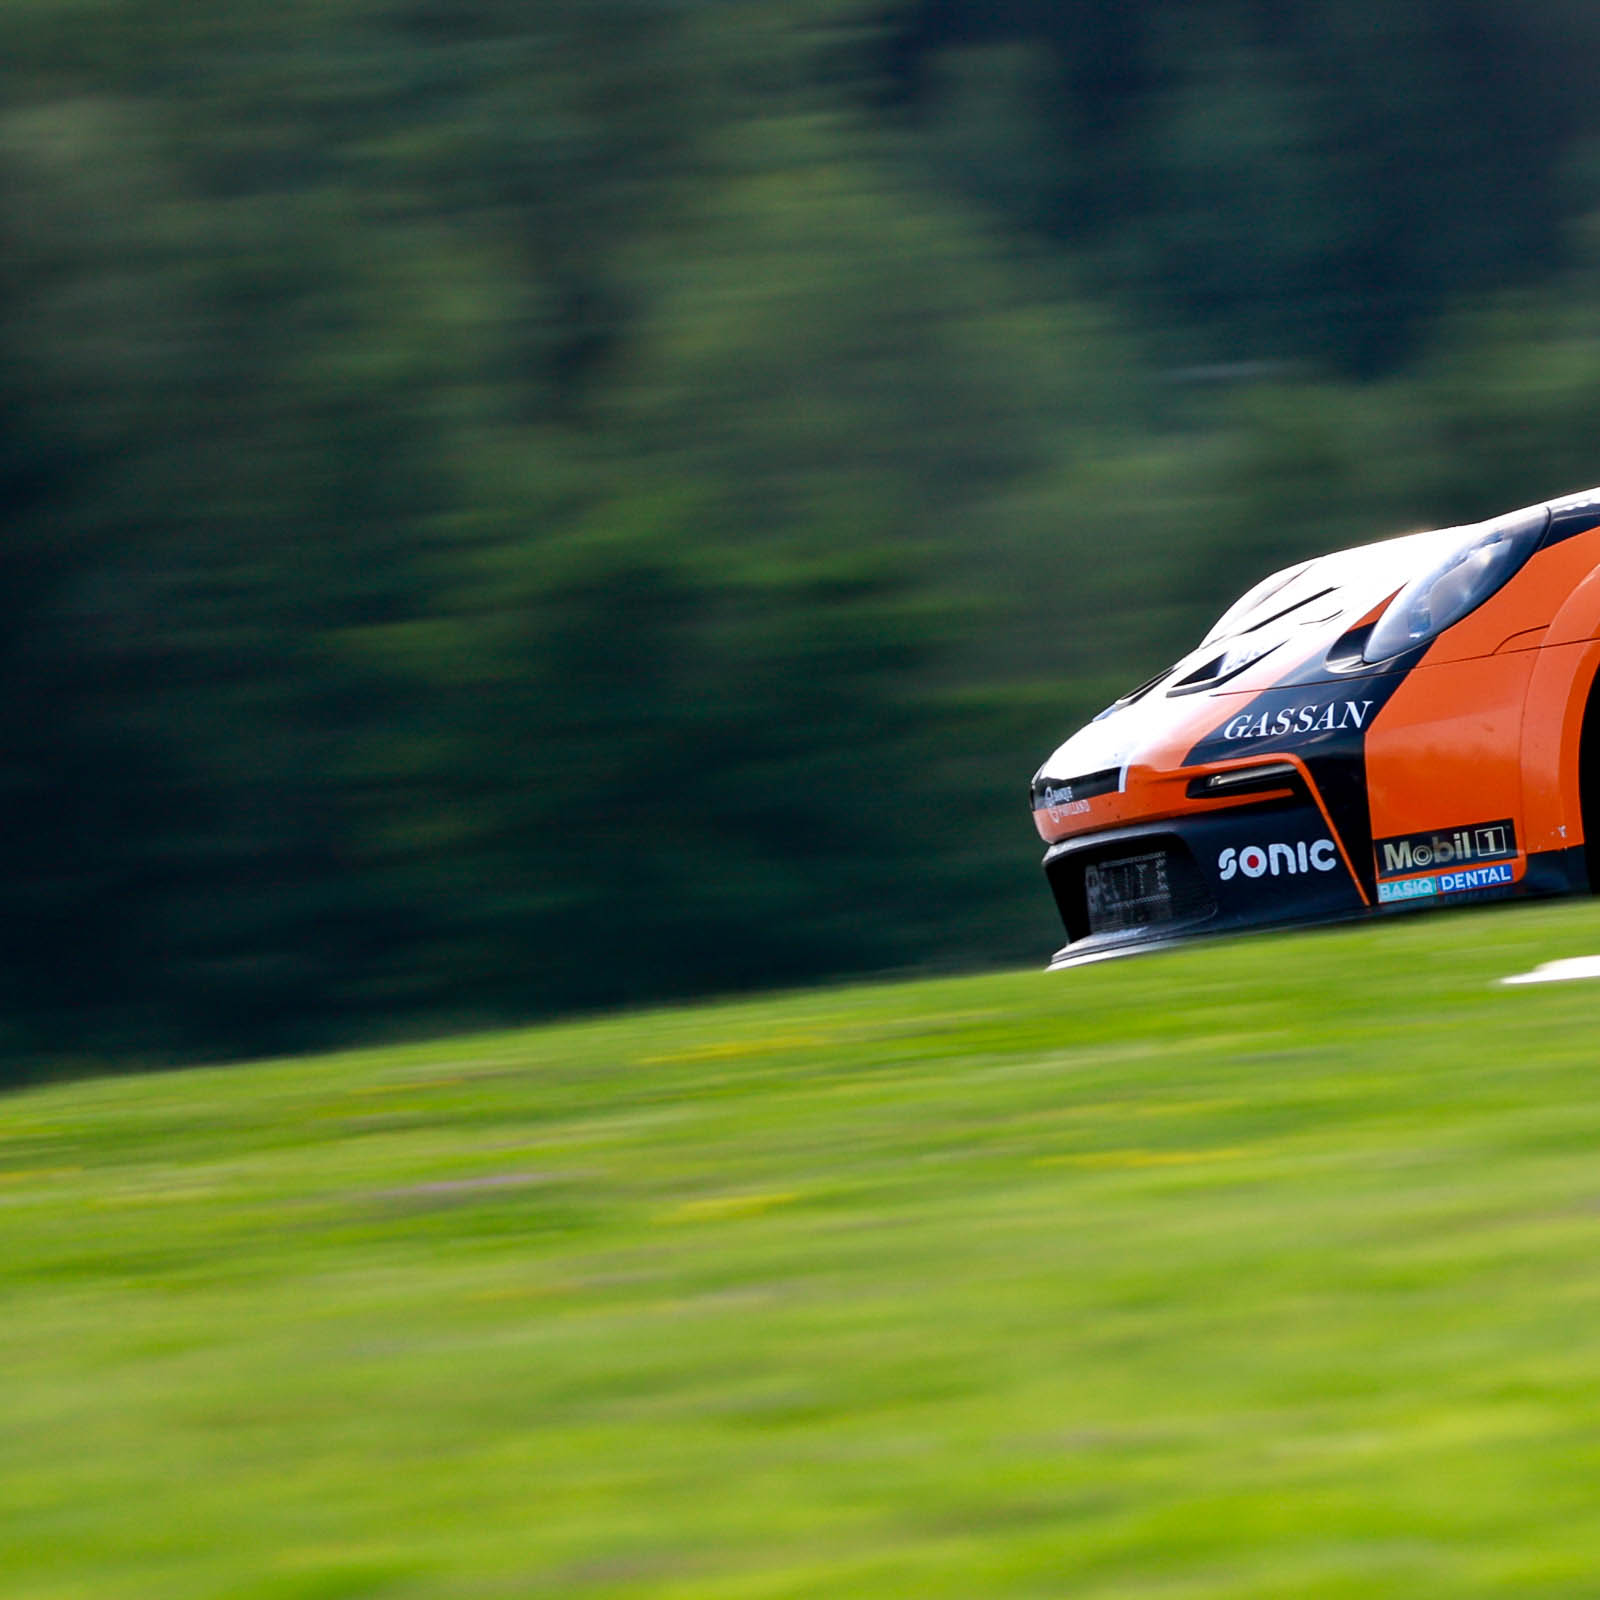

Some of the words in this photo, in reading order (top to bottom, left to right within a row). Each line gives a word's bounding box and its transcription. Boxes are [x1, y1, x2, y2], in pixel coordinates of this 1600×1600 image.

[1223, 700, 1374, 740] GASSAN
[1383, 831, 1472, 871] Mobil
[1379, 880, 1434, 900] BASIQ
[1441, 866, 1512, 892] DENTAL
